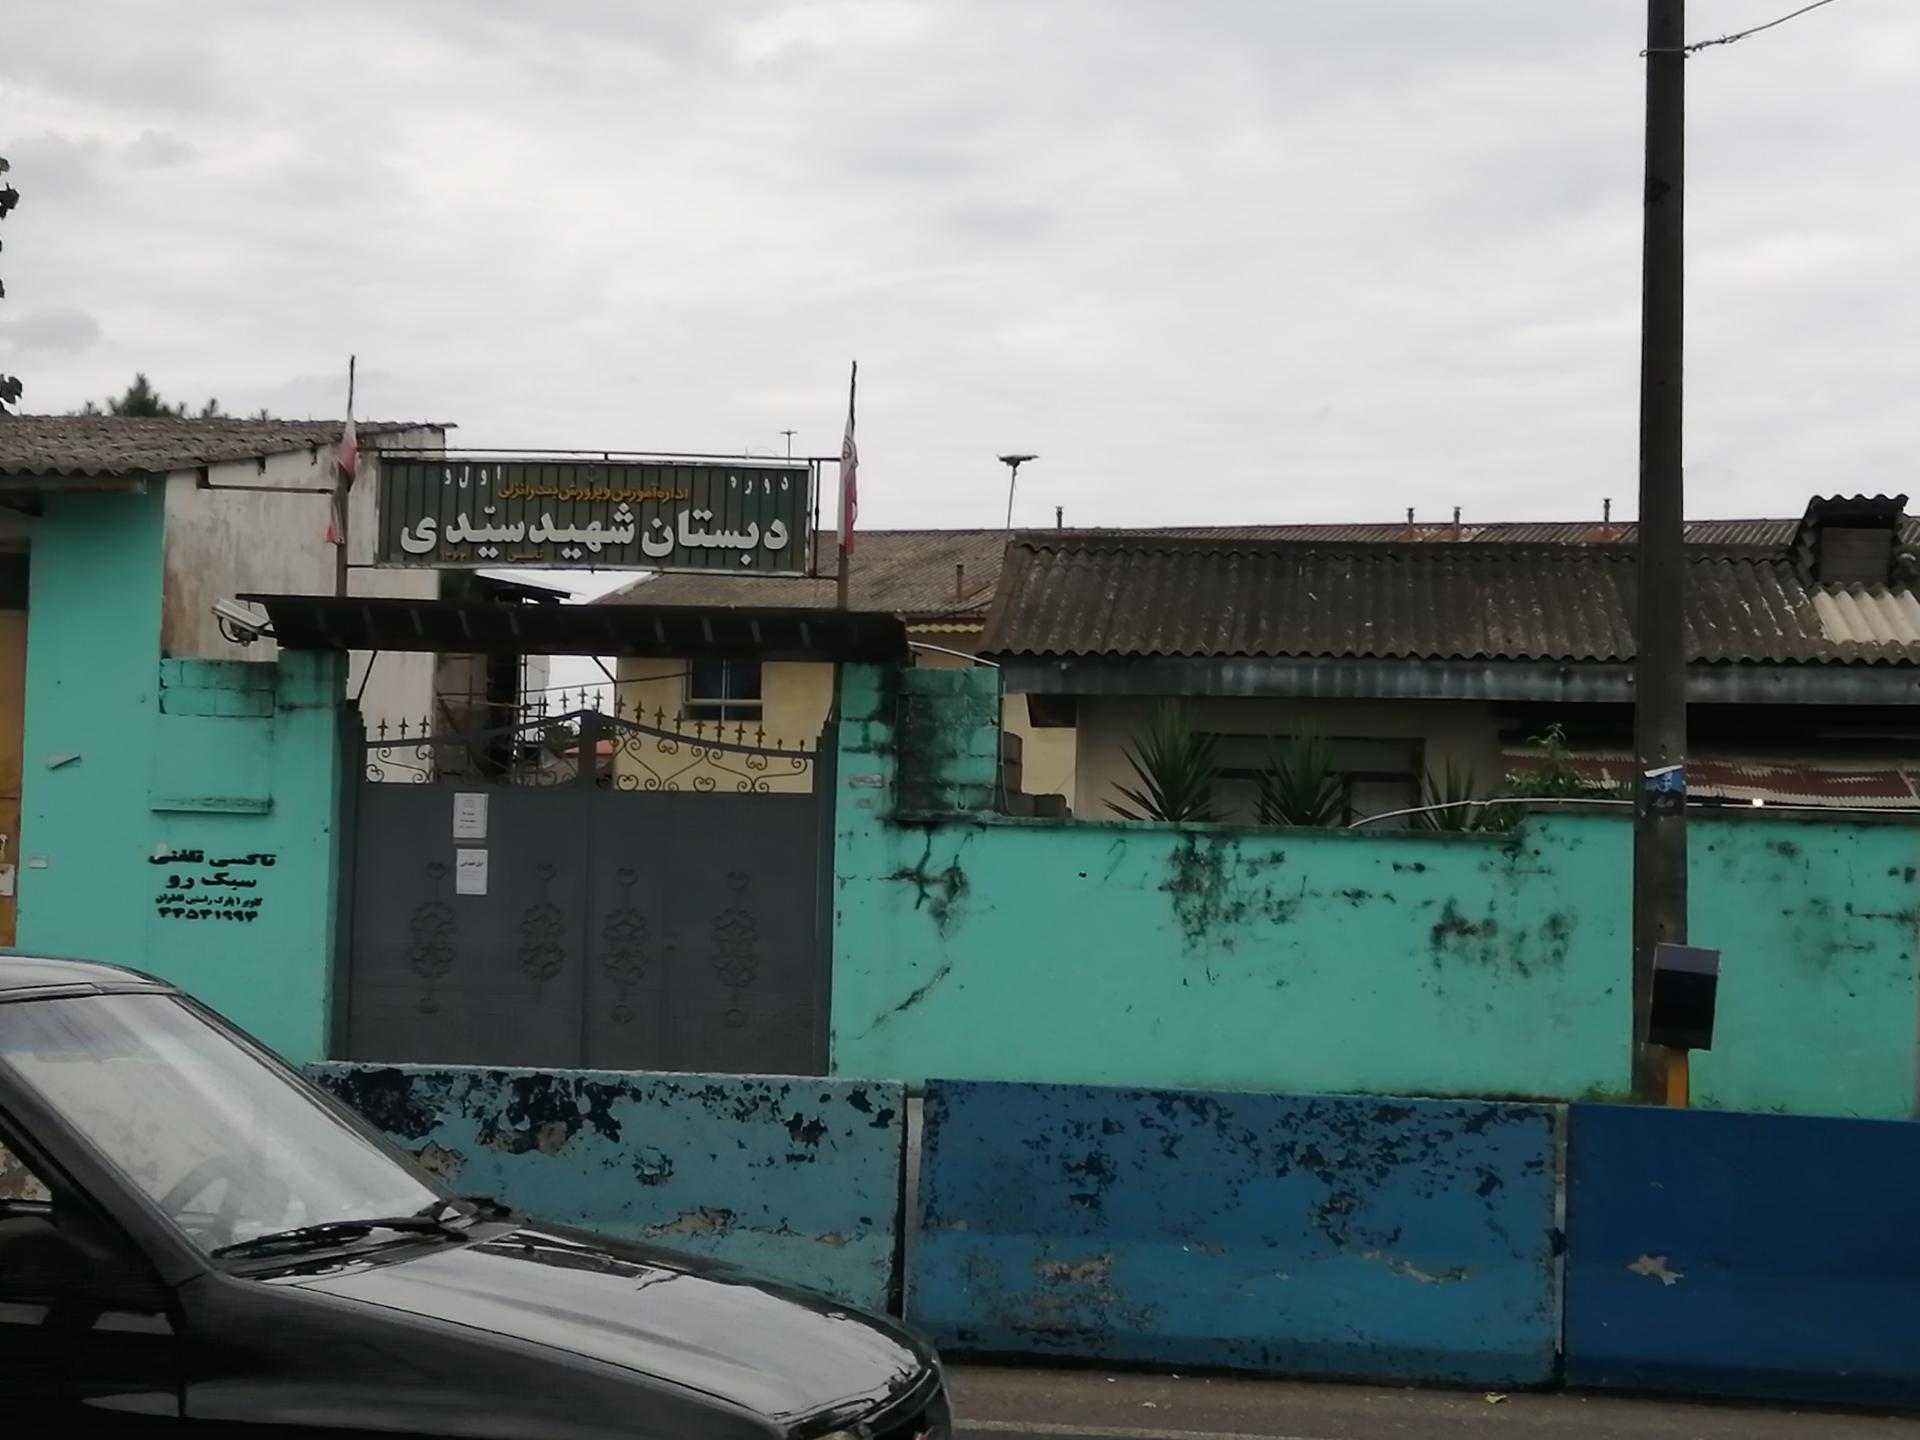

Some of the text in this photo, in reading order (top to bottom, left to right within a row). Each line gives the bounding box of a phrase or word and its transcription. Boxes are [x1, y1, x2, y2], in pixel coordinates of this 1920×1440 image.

[656, 486, 689, 504] اداره
[528, 502, 636, 560] شهید
[641, 508, 789, 566] دبستان
[147, 849, 277, 868] تاکسی تلفنی
[200, 871, 257, 891] سبک
